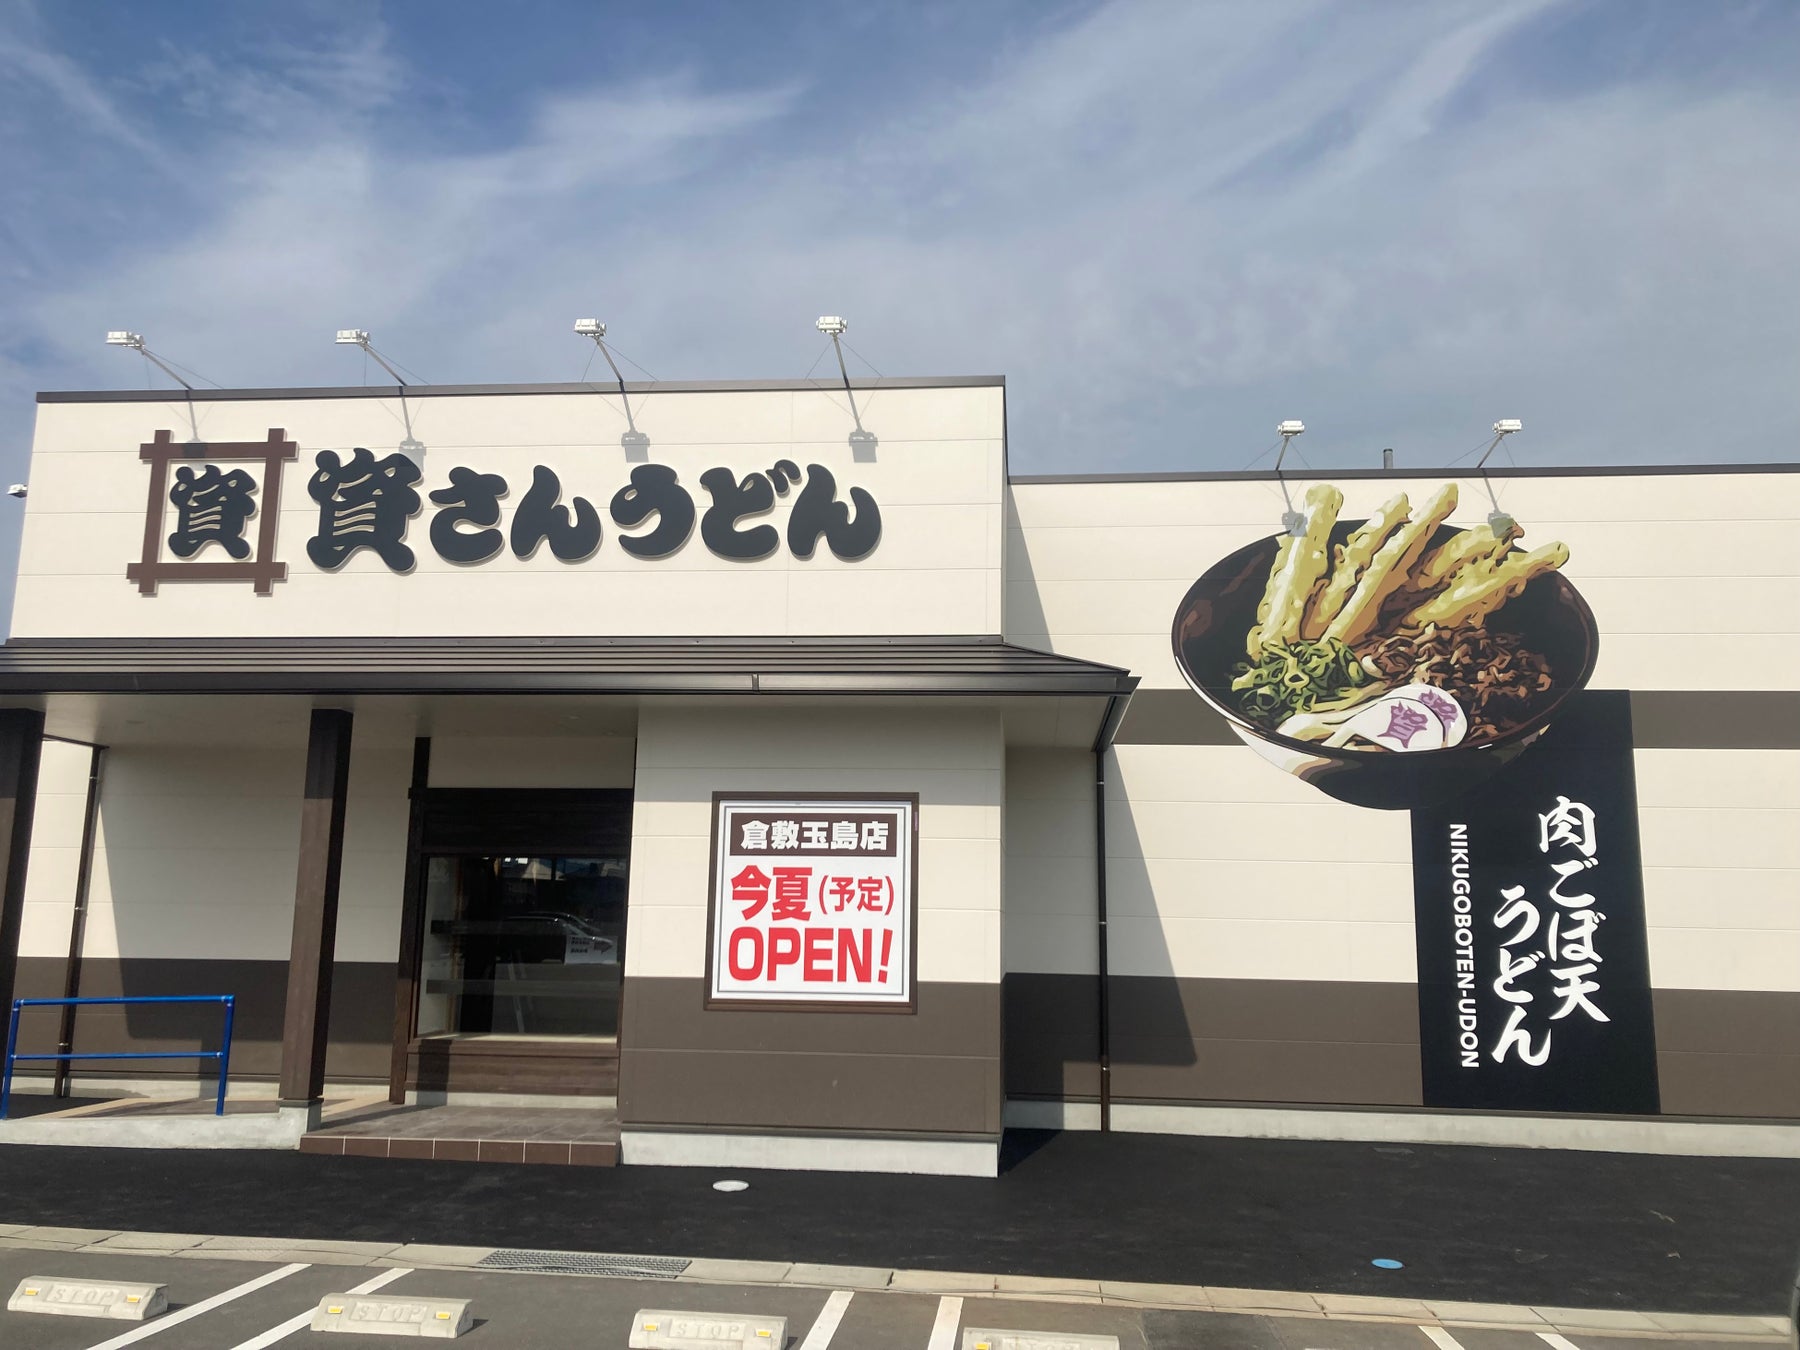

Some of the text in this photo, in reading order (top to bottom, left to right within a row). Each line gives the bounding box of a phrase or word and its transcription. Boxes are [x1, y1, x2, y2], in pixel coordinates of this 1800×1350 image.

[169, 464, 257, 559] 資
[307, 447, 881, 572] 資さんうどん
[740, 820, 890, 851] 倉敷玉島店
[728, 926, 894, 984] OPEN!
[1449, 823, 1480, 1068] NIKUGOBOTEN-UDON
[1538, 795, 1611, 1023] 肉ごぼ天
[1491, 884, 1552, 1067] うどん
[676, 1323, 741, 1340] STOP
